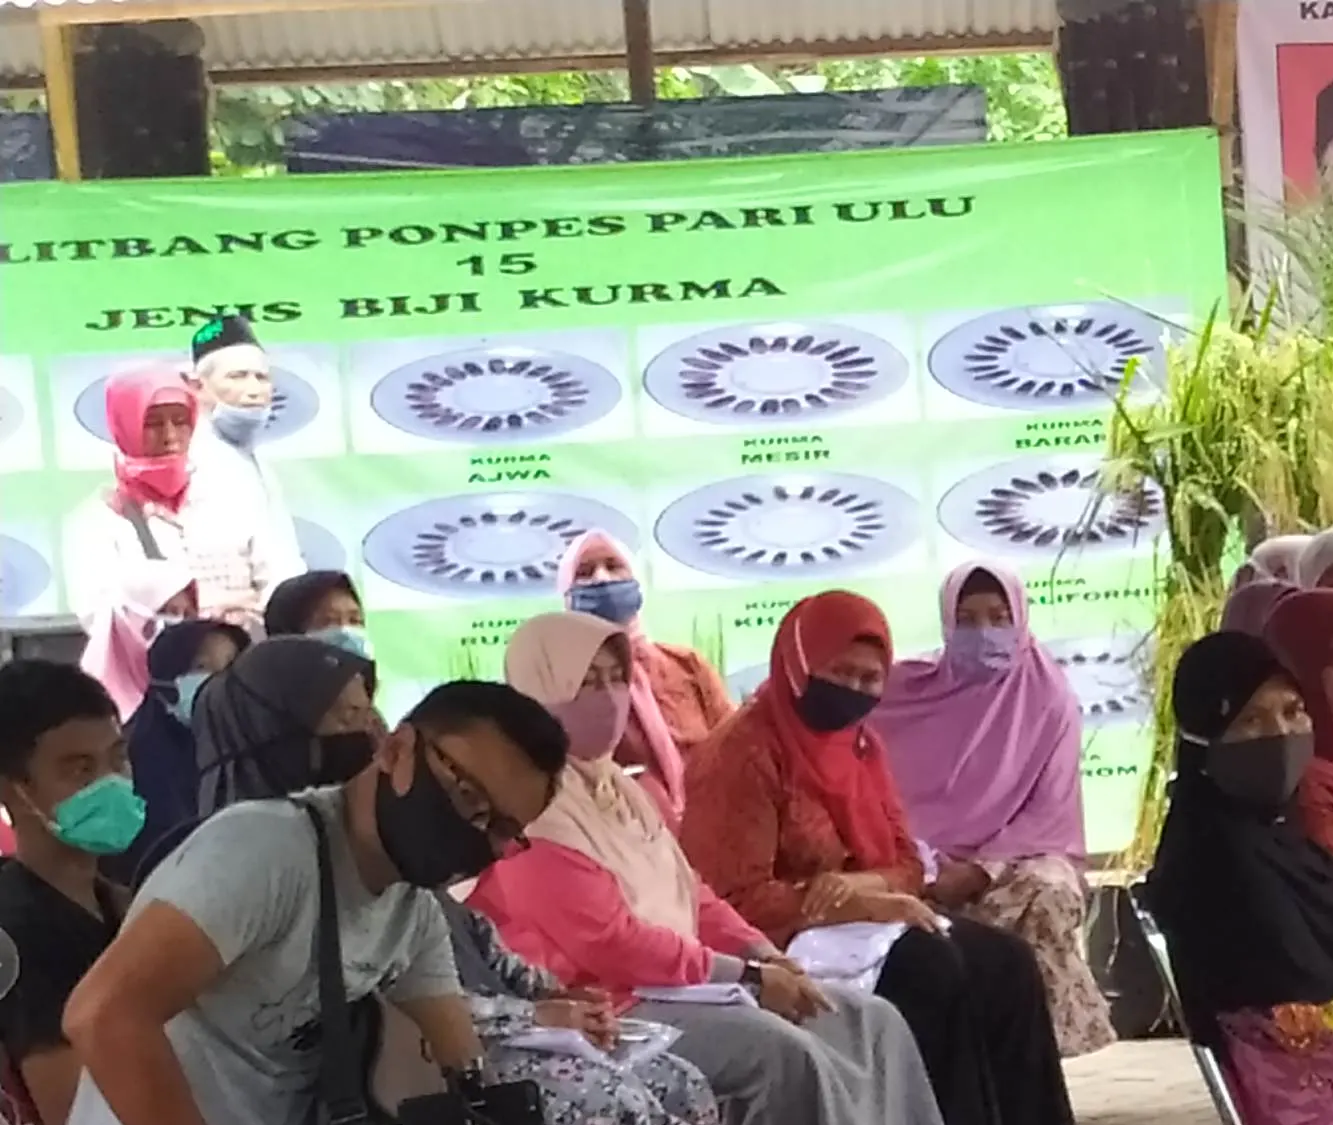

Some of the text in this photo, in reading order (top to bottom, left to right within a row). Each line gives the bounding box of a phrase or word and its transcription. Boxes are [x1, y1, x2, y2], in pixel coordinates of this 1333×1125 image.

[0, 196, 974, 264] LITBANG PONPES PARI ULU
[456, 252, 537, 276] 15
[85, 276, 787, 331] JENIS BIJI KURMA
[1026, 418, 1103, 431] KURMA
[743, 435, 823, 447] KURMA
[471, 453, 552, 465] KURMA
[741, 449, 830, 465] MESIR
[468, 469, 552, 483] AJWA
